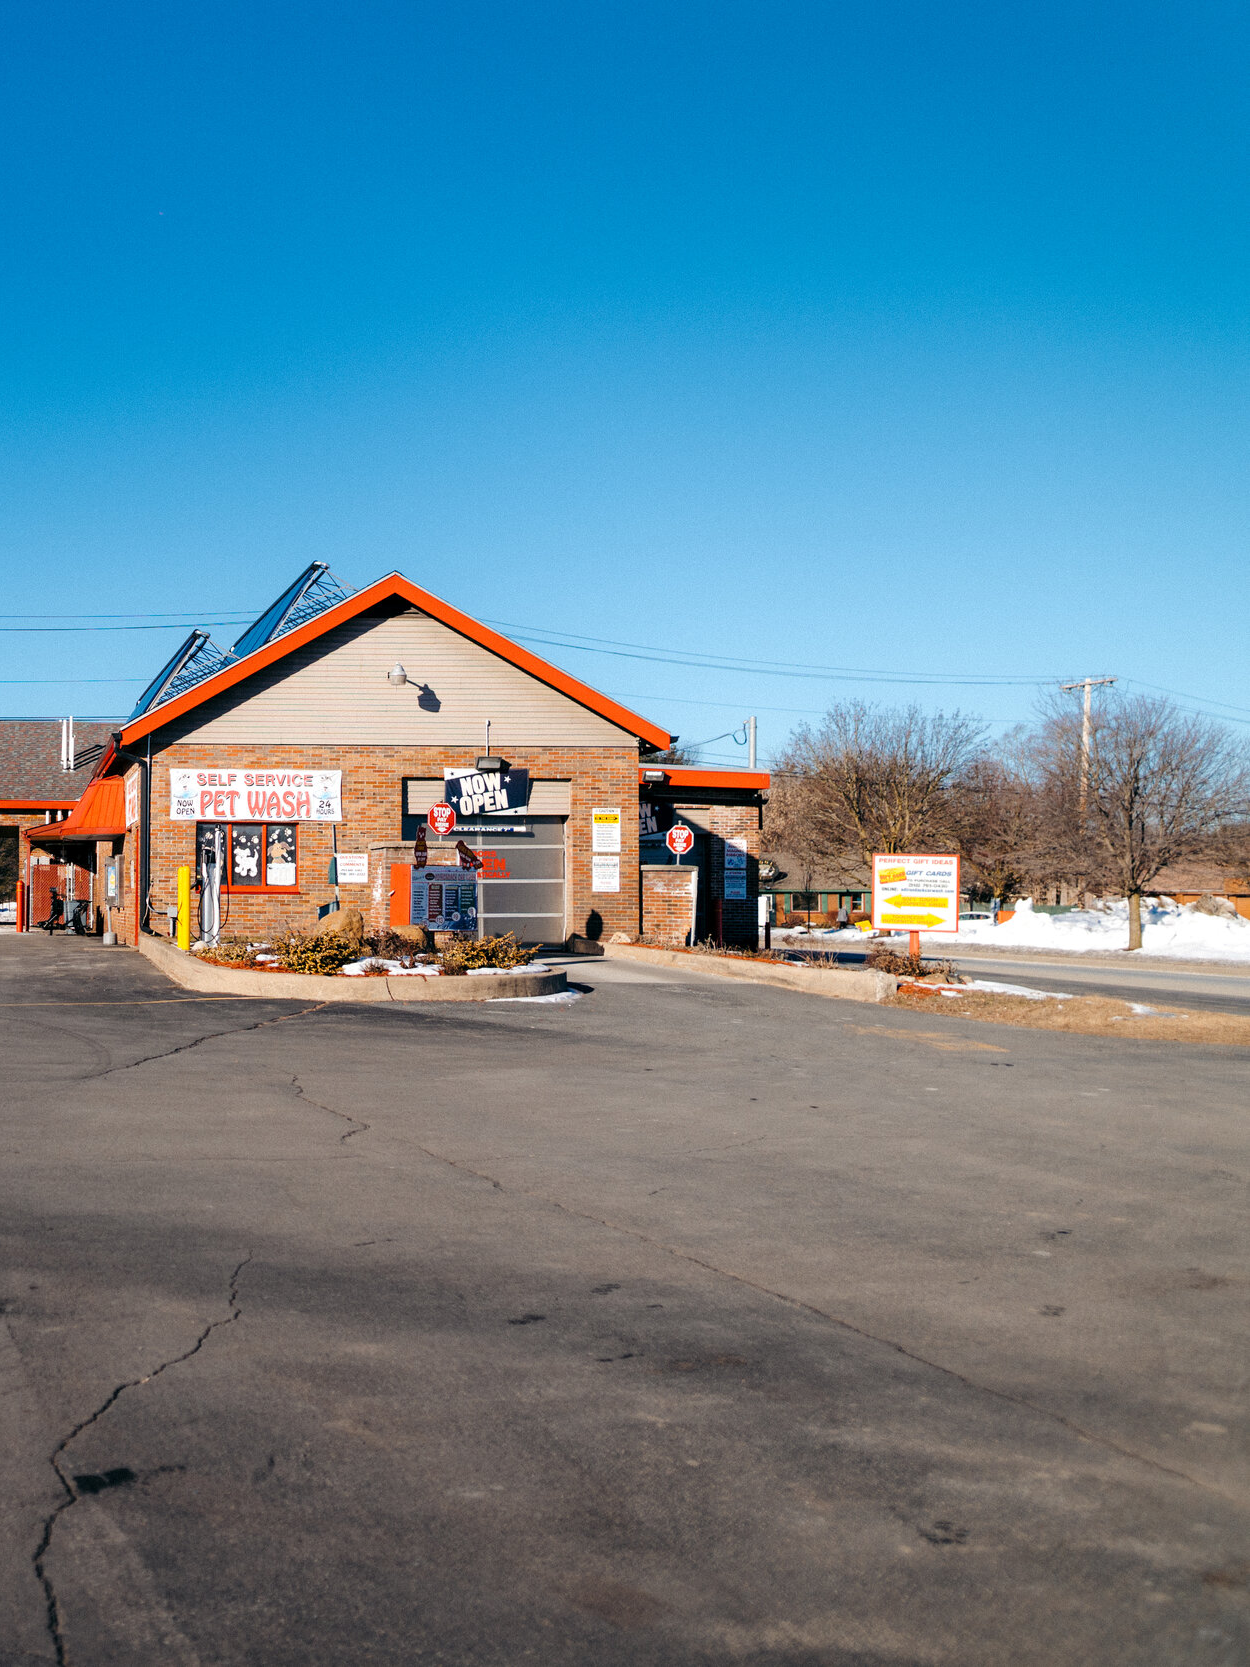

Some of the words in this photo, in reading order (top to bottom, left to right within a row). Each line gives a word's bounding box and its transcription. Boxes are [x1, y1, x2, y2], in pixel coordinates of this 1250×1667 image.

[196, 772, 237, 787] SELF
[243, 773, 314, 788] SERVICE
[459, 771, 501, 797] NOW
[176, 799, 194, 807] NOW
[199, 790, 241, 818] PET
[246, 790, 312, 818] WASH
[318, 800, 332, 809] 24
[459, 788, 509, 816] OPEN
[176, 807, 196, 815] OPEN
[433, 806, 451, 818] STOP
[671, 829, 689, 839] STOP
